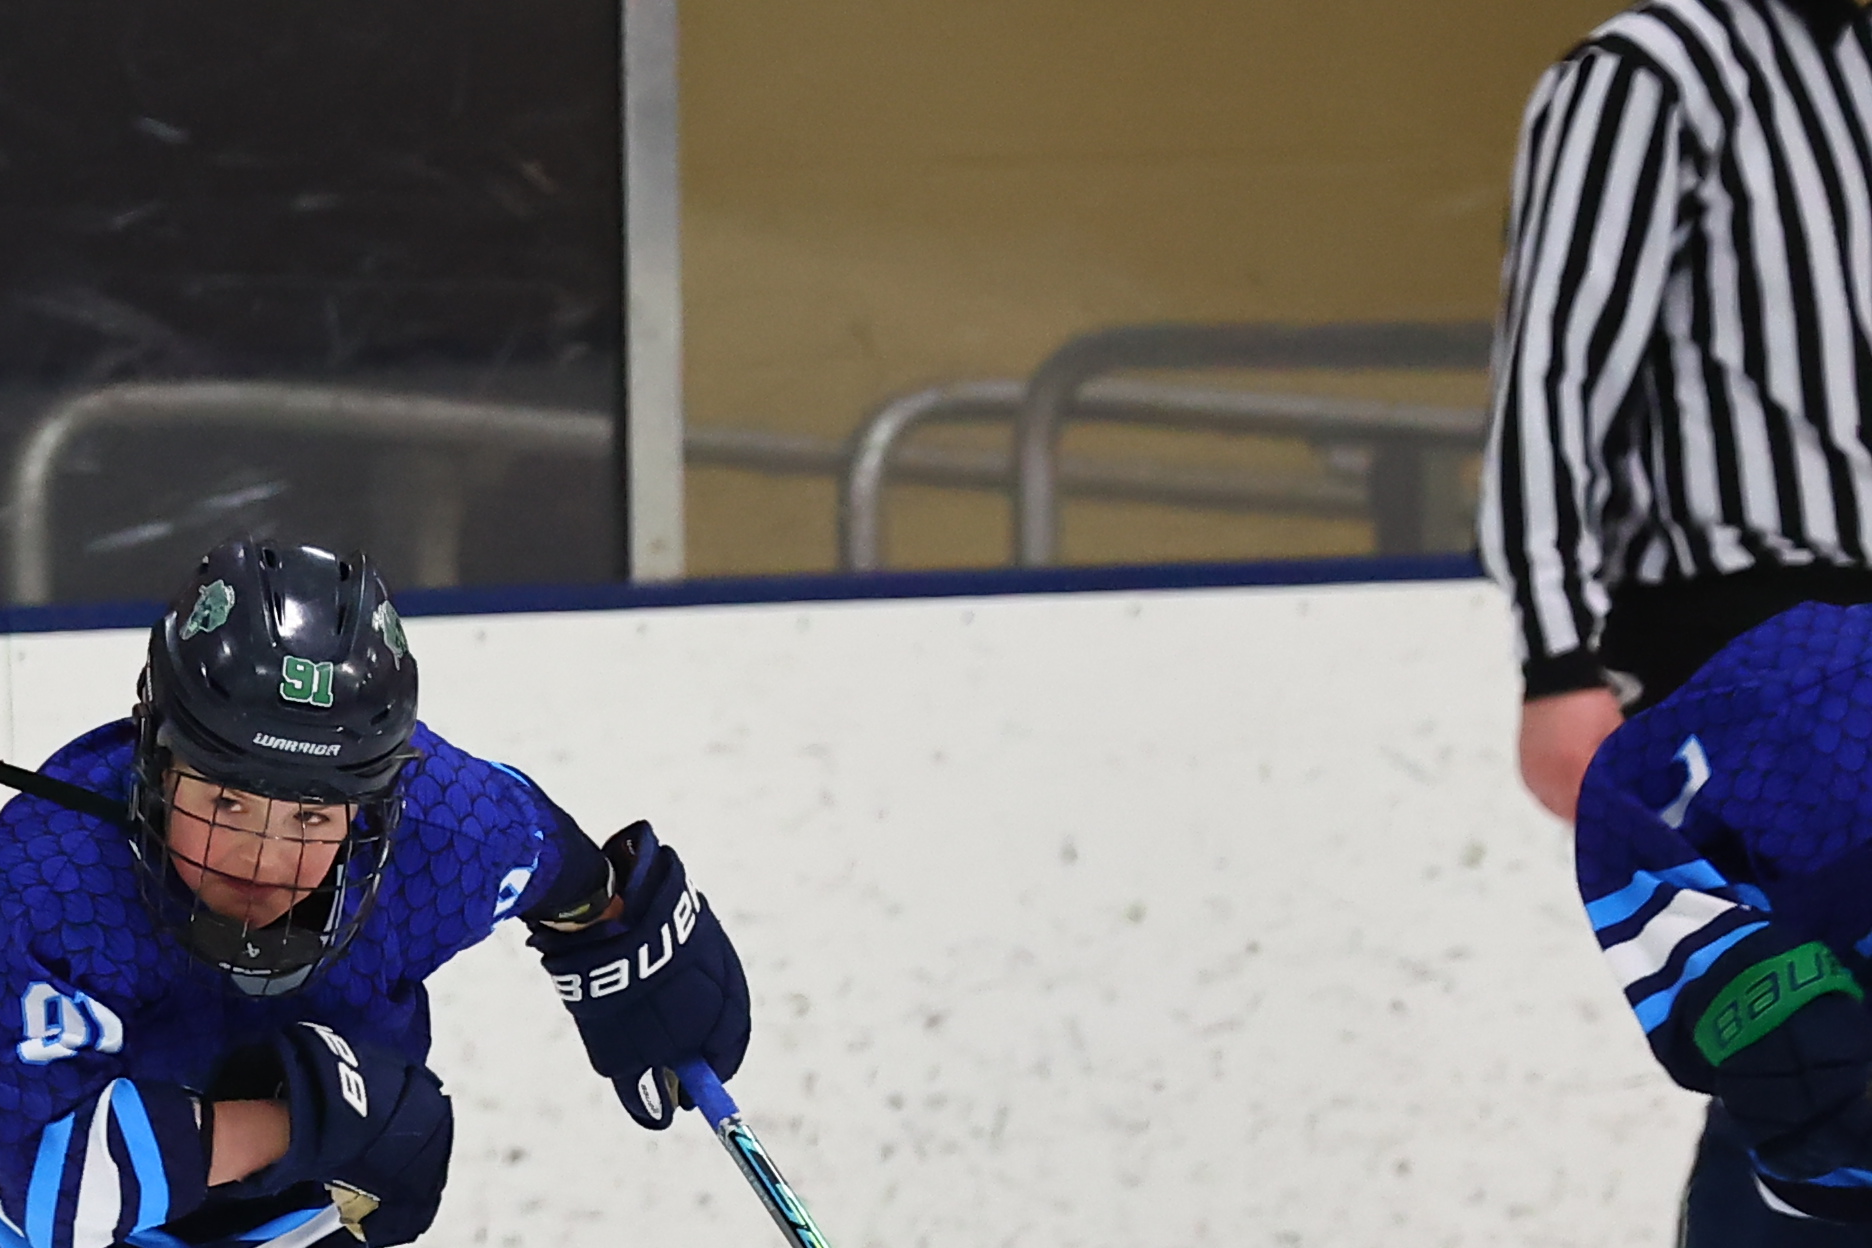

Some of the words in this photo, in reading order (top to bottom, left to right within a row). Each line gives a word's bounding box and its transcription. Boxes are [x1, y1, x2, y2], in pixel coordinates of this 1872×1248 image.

[280, 656, 334, 707] 91
[253, 732, 341, 756] WARRIOR
[1714, 951, 1842, 1048] BAU
